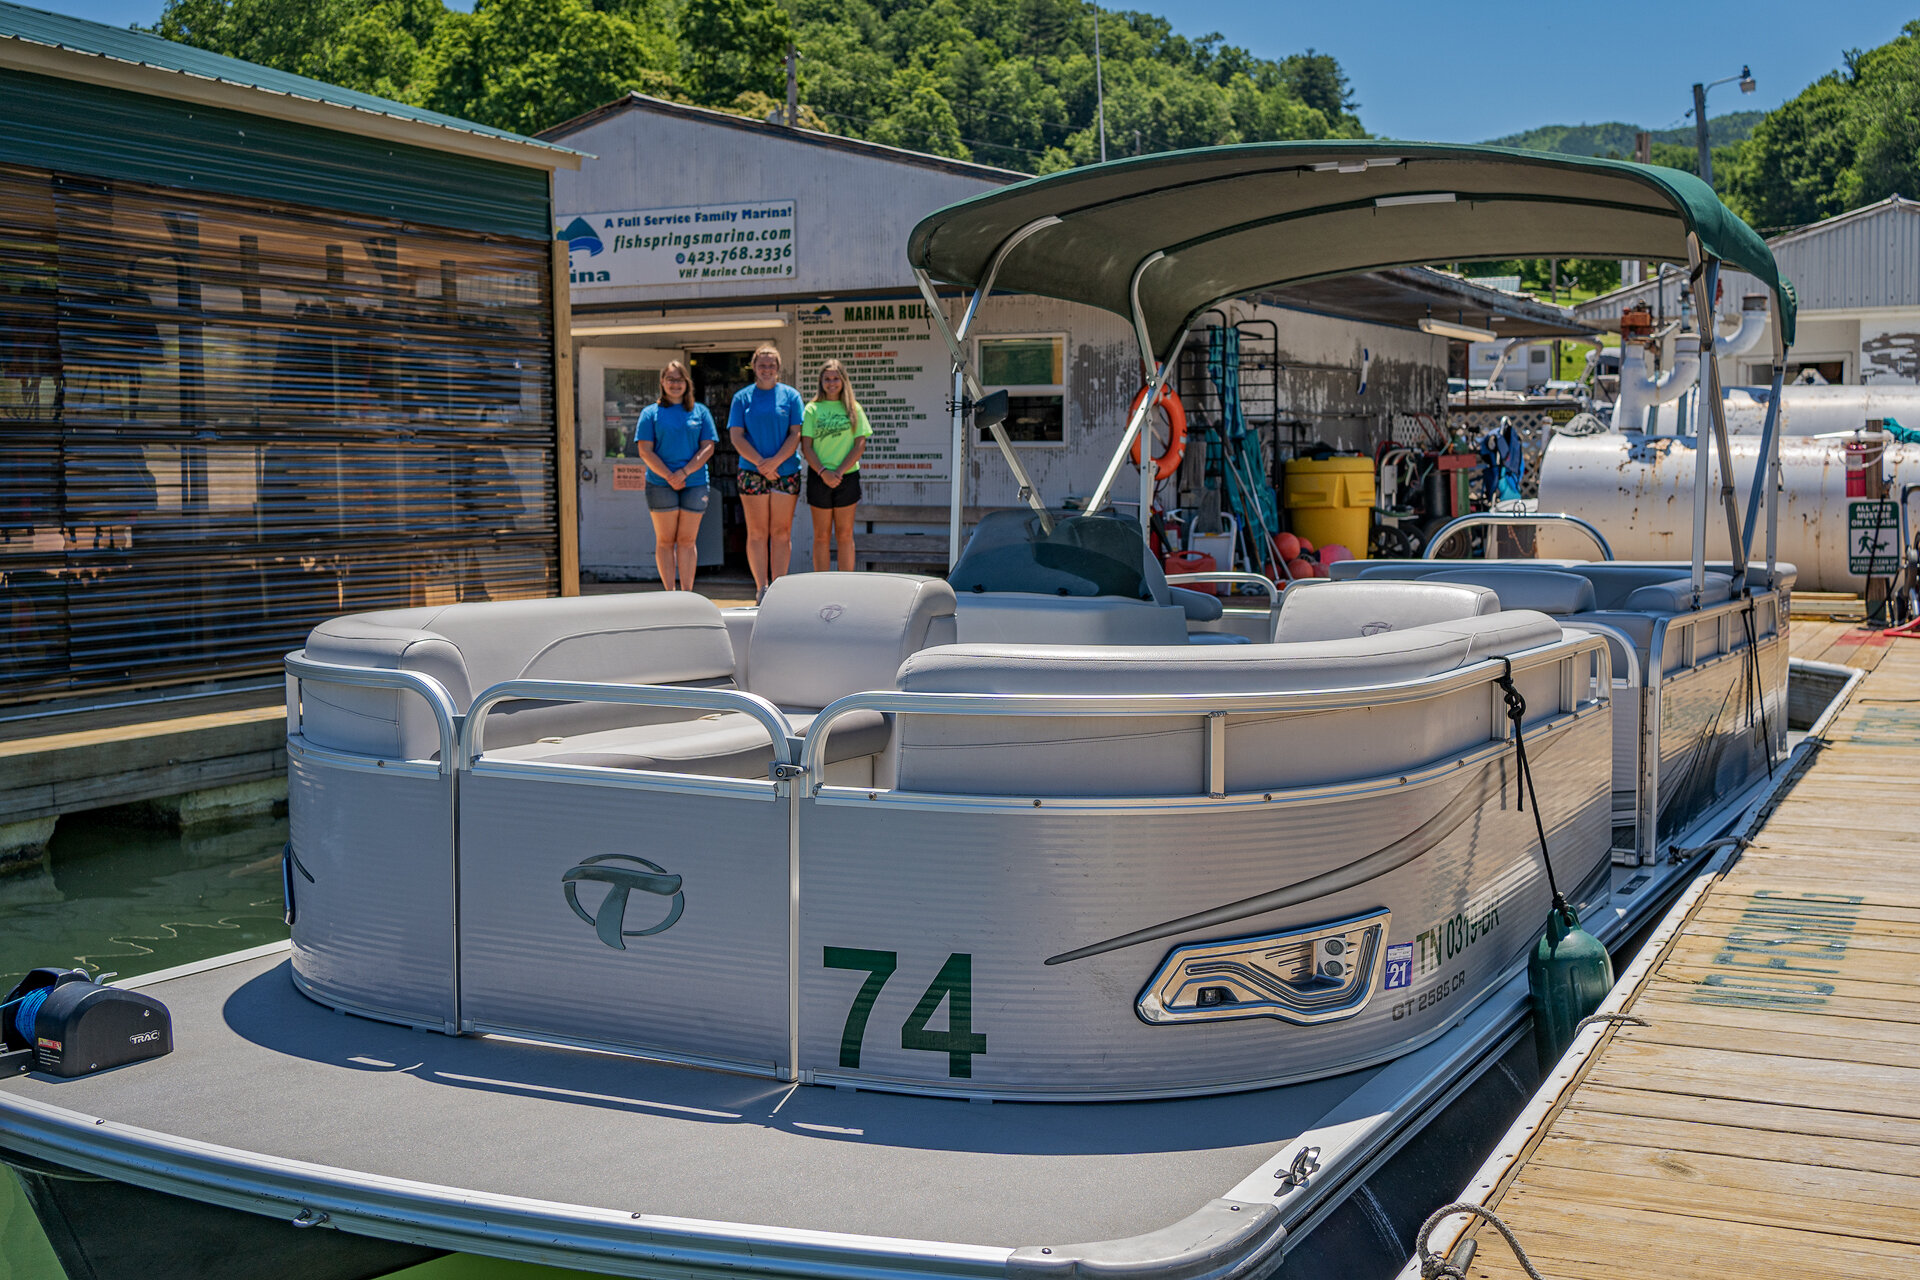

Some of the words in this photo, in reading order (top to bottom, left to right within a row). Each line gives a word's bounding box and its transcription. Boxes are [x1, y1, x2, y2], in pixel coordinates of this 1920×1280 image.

[605, 218, 614, 229] A
[618, 216, 640, 228] Full
[644, 215, 691, 226] Service
[695, 211, 737, 224] Family
[742, 207, 792, 219] Marina!
[613, 229, 791, 253] fishspringsmarina.com
[687, 243, 792, 265] 423.768.2336
[570, 270, 610, 284] ina
[679, 269, 698, 279] VHF
[702, 267, 736, 279] Marine
[740, 266, 782, 278] Channel
[786, 266, 793, 275] 9
[844, 305, 894, 321] MARINA
[1416, 924, 1442, 975] TN
[1389, 962, 1406, 987] 21
[1392, 998, 1415, 1021] GT
[1418, 980, 1450, 1011] 2585
[823, 946, 987, 1079] 74
[131, 1031, 159, 1044] TRAC
